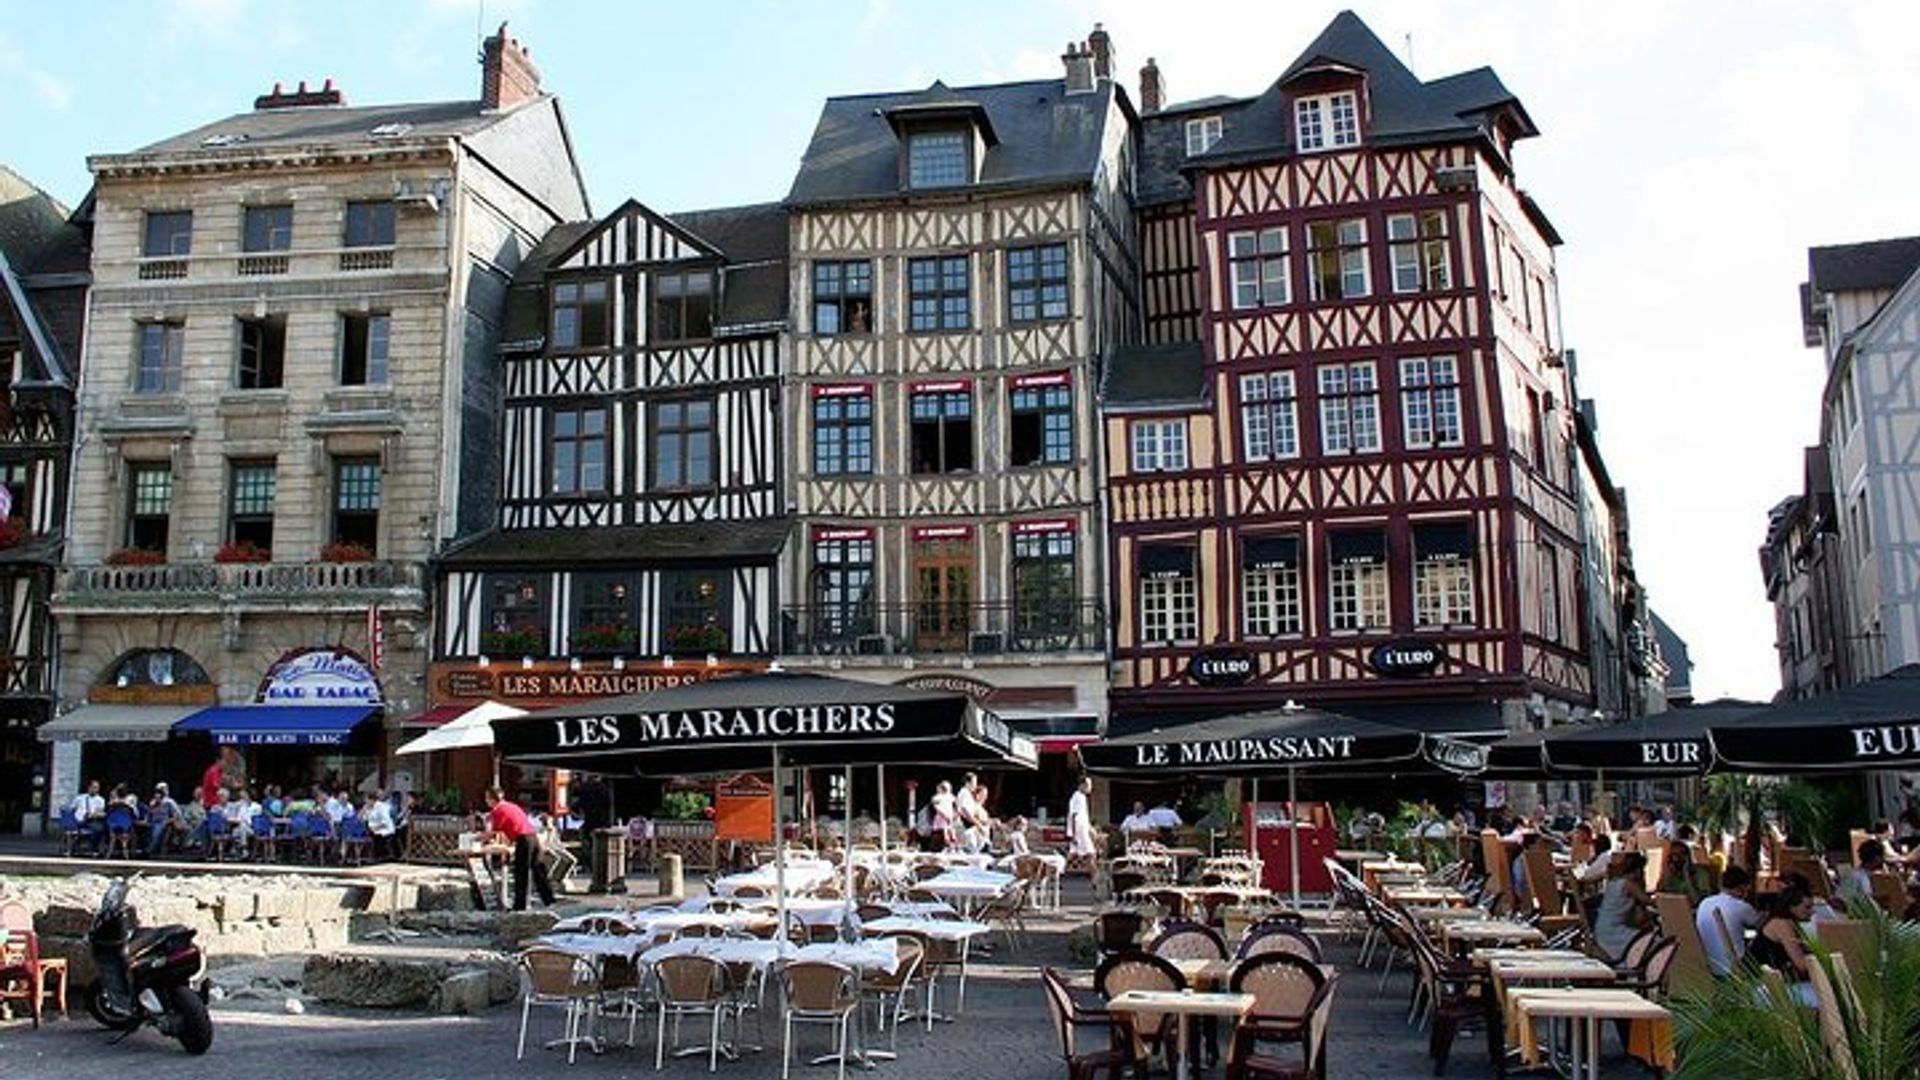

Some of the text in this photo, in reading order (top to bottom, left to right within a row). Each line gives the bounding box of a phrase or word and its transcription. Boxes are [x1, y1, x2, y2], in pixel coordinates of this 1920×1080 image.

[1385, 650, 1434, 666] L'EURO
[1201, 659, 1250, 675] L'EURO
[268, 686, 375, 699] BAR TABAC
[503, 676, 540, 694] LES
[555, 702, 895, 747] LES MARAICHERS
[218, 733, 239, 744] BAR
[1136, 735, 1356, 766] LE MAUPASSANT
[1640, 741, 1700, 763] EUR
